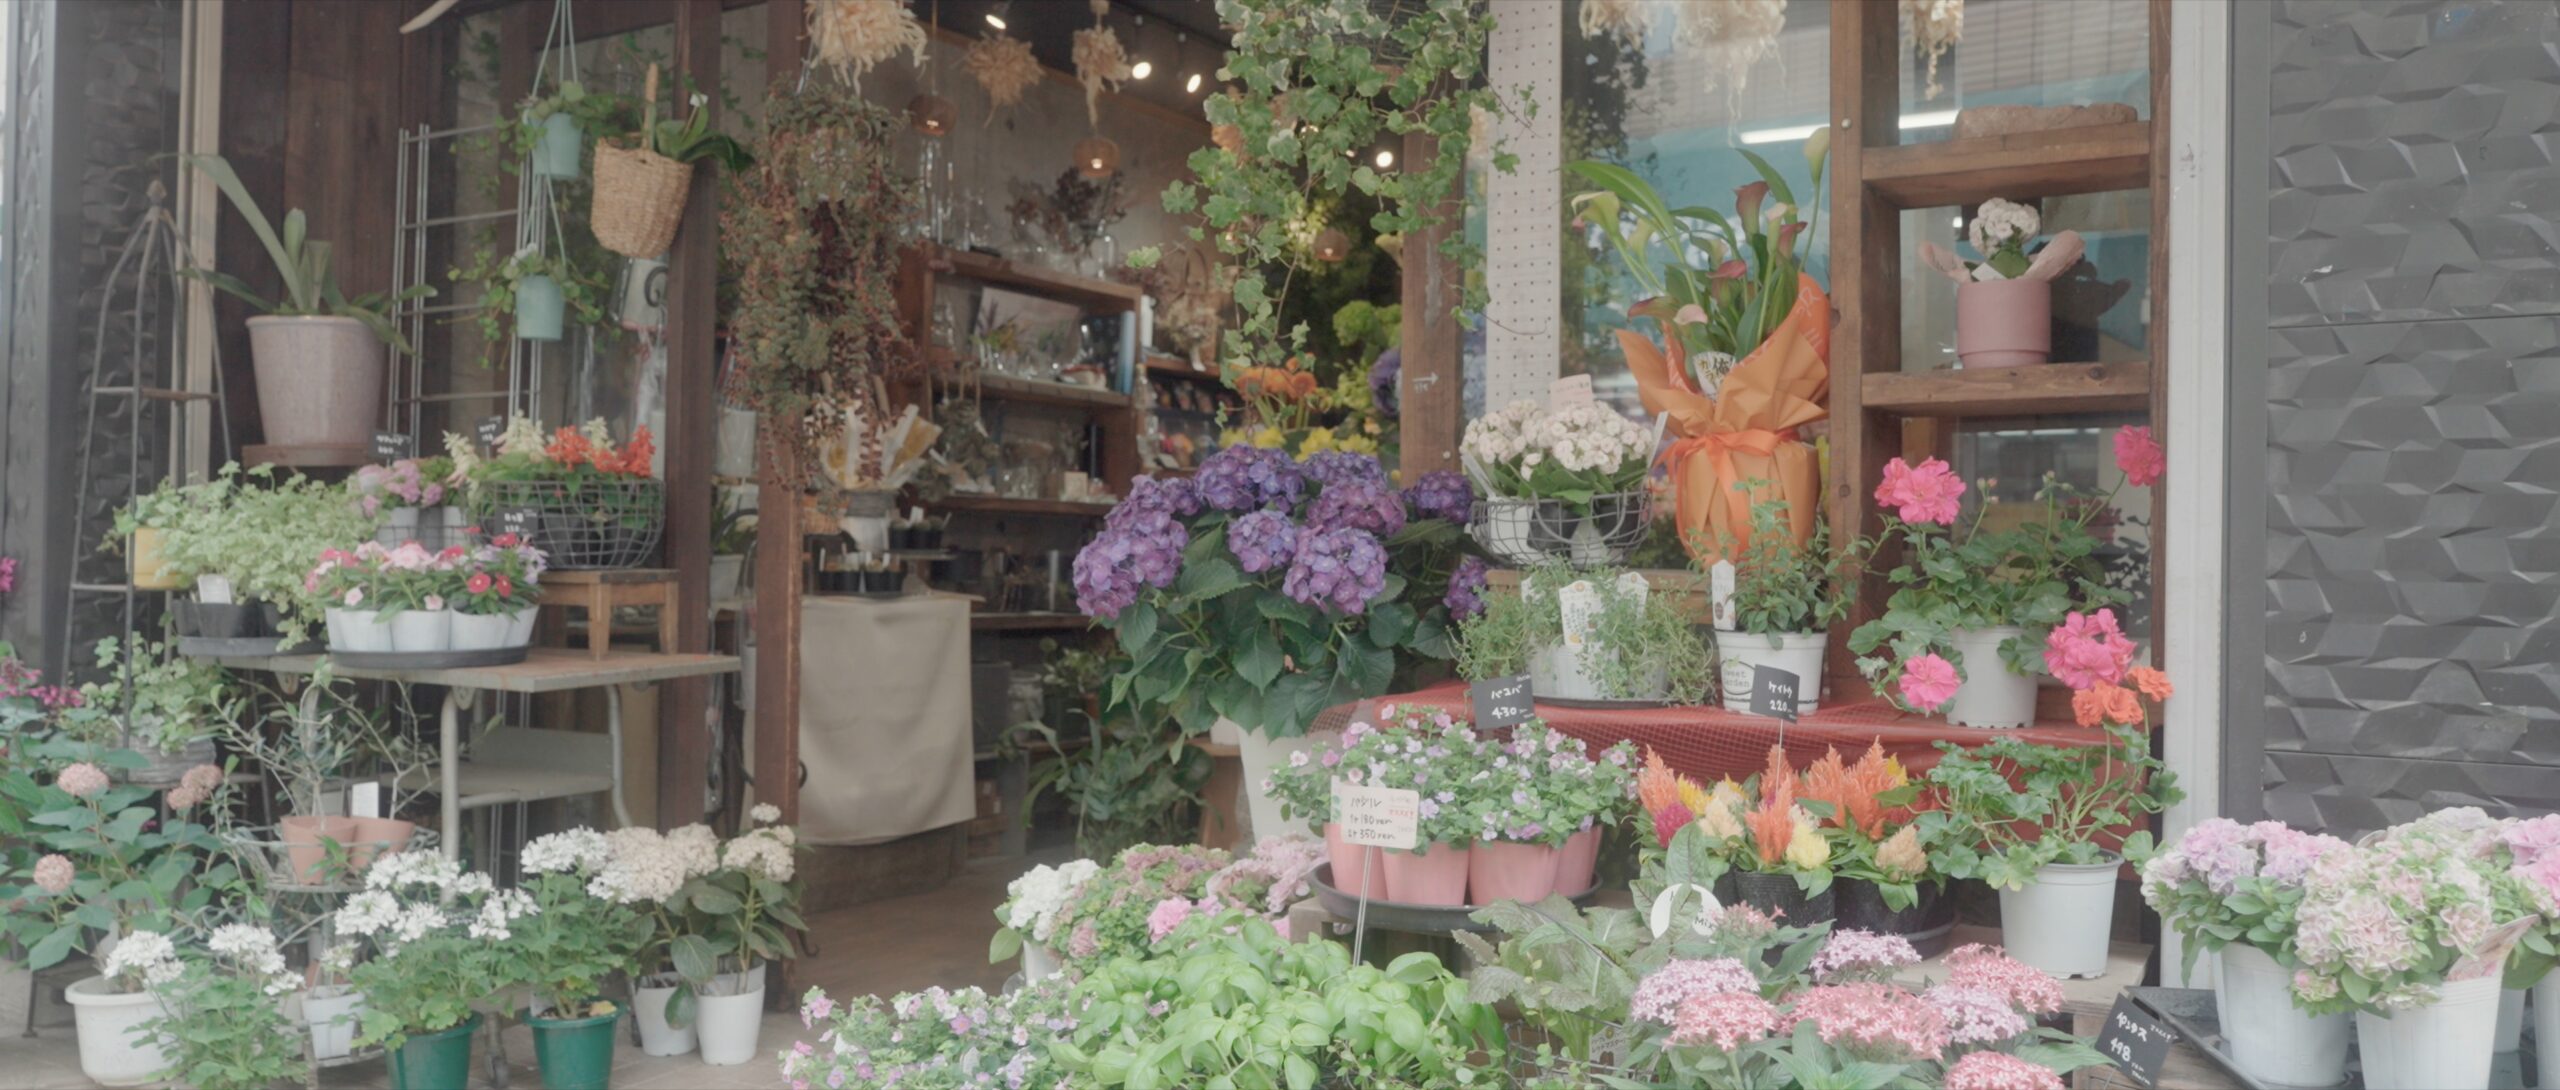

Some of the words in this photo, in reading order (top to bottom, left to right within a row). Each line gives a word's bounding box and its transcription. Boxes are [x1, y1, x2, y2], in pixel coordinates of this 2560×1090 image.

[1769, 699, 1788, 712] 220
[1491, 706, 1518, 720] 430
[2110, 1037, 2131, 1062] 498
